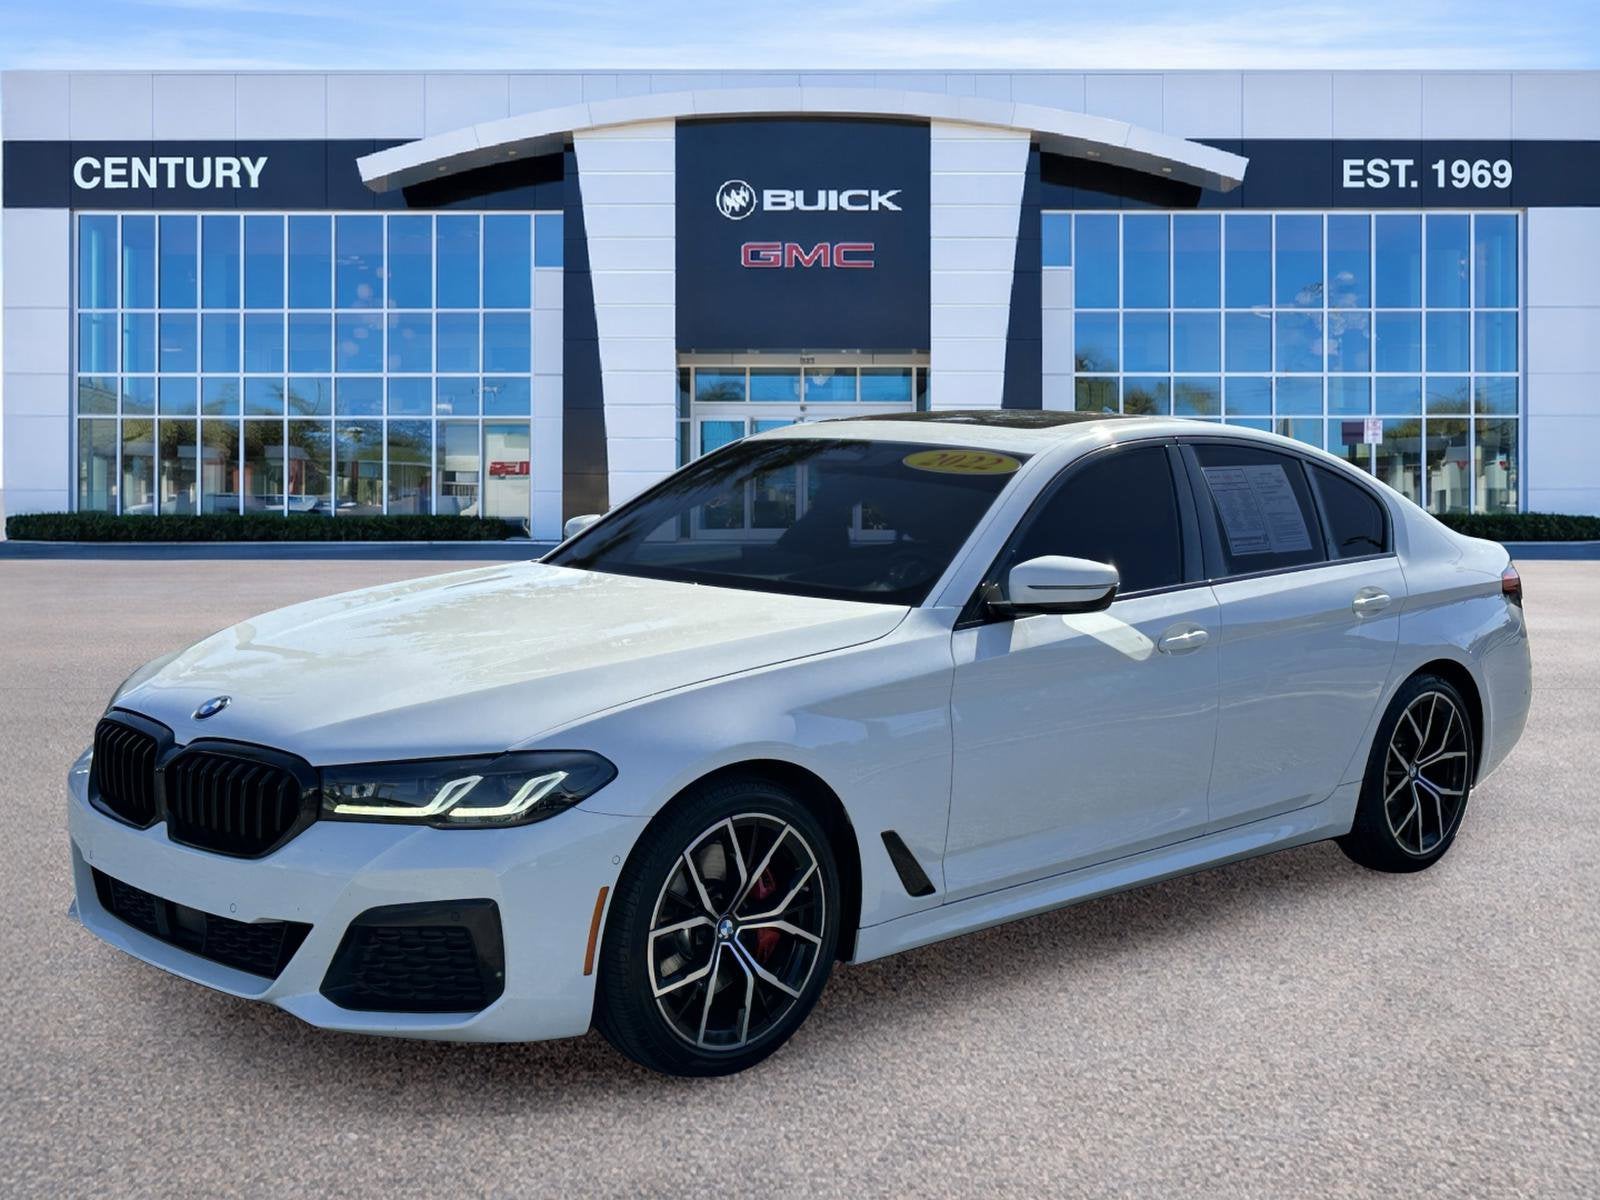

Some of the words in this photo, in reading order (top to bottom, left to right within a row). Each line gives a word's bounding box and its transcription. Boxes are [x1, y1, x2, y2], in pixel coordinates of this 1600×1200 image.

[73, 156, 268, 191] CENTURY
[1342, 158, 1418, 189] EST.
[1431, 159, 1513, 189] 1969
[762, 188, 903, 212] BUICK
[740, 241, 876, 269] GMC
[917, 452, 1005, 471] 2022
